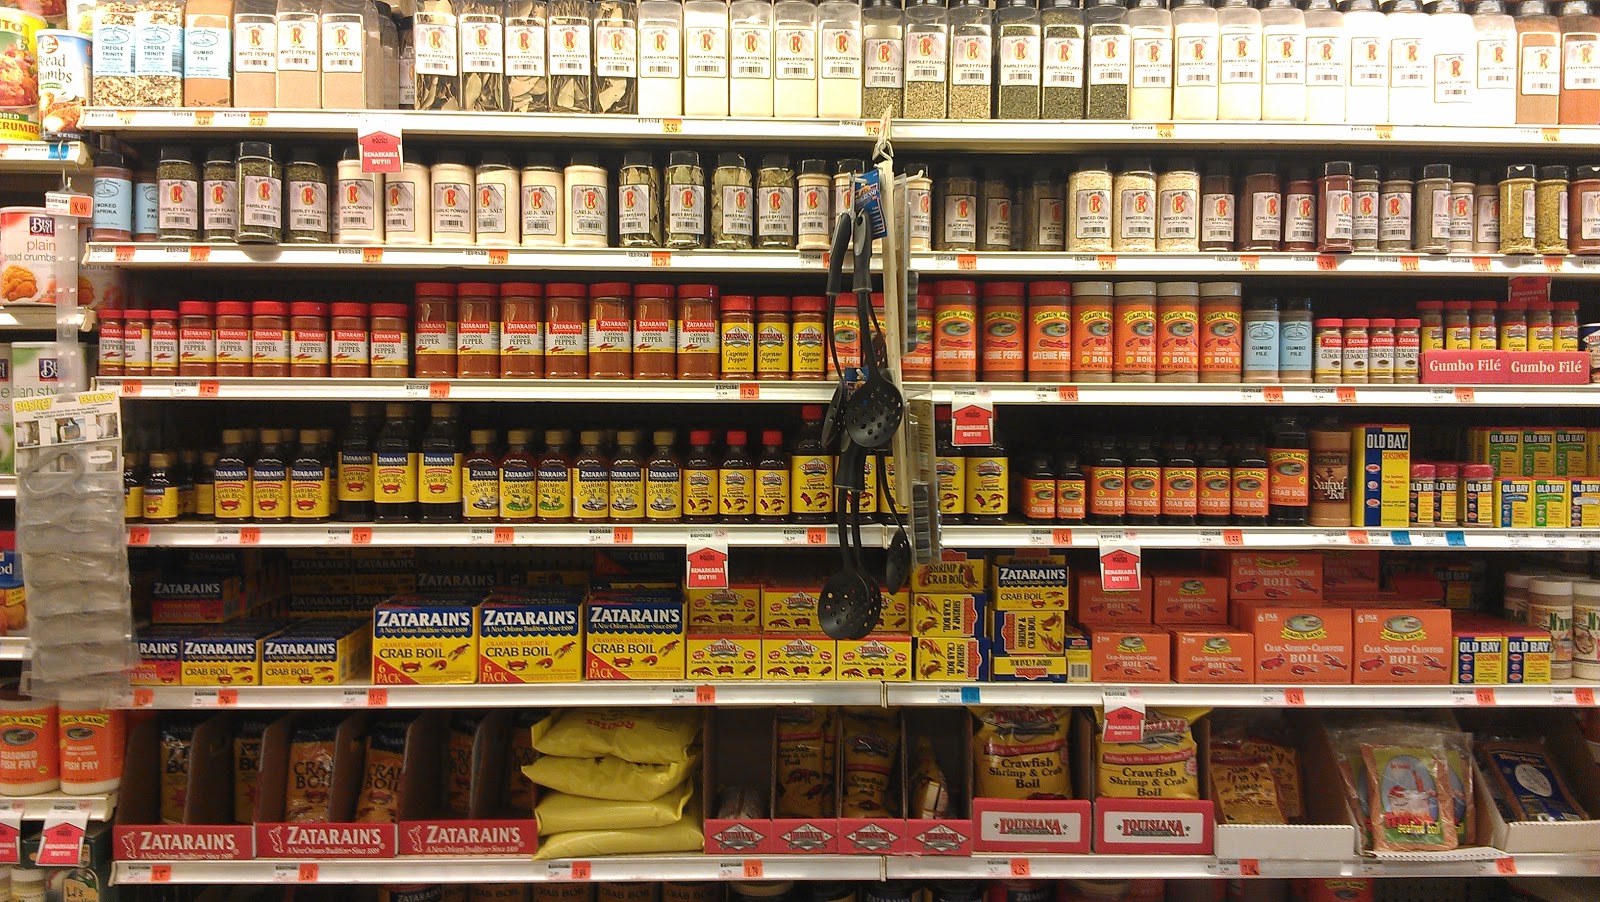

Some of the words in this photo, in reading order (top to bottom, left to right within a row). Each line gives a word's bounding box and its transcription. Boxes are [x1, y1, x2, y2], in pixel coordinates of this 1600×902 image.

[363, 151, 399, 159] REMARKABLE
[727, 356, 747, 364] Pepper
[761, 356, 780, 364] Pepper
[797, 356, 819, 365] Pepper
[1429, 360, 1474, 372] Gumbo
[1477, 359, 1502, 371] Filé
[1511, 361, 1557, 373] Gumbo
[1558, 361, 1583, 373] Filé
[15, 397, 52, 413] BASKET
[1366, 433, 1386, 450] OLD
[1387, 434, 1408, 450] BAY
[1490, 433, 1502, 443] OLD
[1503, 433, 1518, 443] BAY
[1524, 433, 1536, 443] OLD
[1537, 433, 1551, 443] BAY
[1557, 432, 1569, 443] OLD
[1570, 432, 1584, 443] BAY
[1382, 452, 1408, 461] SEASONING
[1271, 489, 1290, 497] CRAB
[1290, 489, 1309, 497] BOIL
[1467, 483, 1481, 492] OLD
[1502, 483, 1515, 493] OLD
[1515, 483, 1529, 493] BAY
[1536, 483, 1549, 493] OLD
[1550, 483, 1564, 493] BAY
[1572, 483, 1585, 492] OLD
[1585, 483, 1600, 493] BAY
[929, 563, 956, 573] SHRIMP
[927, 574, 946, 584] CRAB
[947, 574, 965, 584] BOIL
[999, 568, 1066, 580] ZATARAIN'S
[1262, 577, 1291, 587] BOIL
[153, 582, 221, 595] ZATARAIN'S
[1000, 593, 1023, 601] CRAB
[1023, 593, 1044, 601] BOIL
[943, 598, 952, 616] CRAB
[377, 609, 471, 627] ZATARAIN'S
[483, 609, 577, 626] ZATARAIN'S
[591, 606, 680, 623] ZATARAIN'S
[1257, 613, 1265, 623] 6
[1264, 613, 1278, 621] PAK
[1357, 614, 1365, 624] 6
[1365, 614, 1378, 622] PAK
[943, 616, 952, 632] BOIL
[1027, 615, 1036, 631] BOIL
[1027, 632, 1036, 649] CRAB
[184, 642, 255, 655] ZATARAIN'S
[265, 642, 336, 655] ZATARAIN'S
[379, 646, 413, 658] CRAB
[415, 646, 446, 658] BOIL
[485, 646, 519, 657] CRAB
[522, 646, 552, 657] BOIL
[592, 643, 626, 654] CRAB
[627, 643, 657, 654] BOIL
[947, 642, 956, 660] CRAB
[1459, 642, 1479, 653] OLD
[1480, 642, 1501, 653] BAY
[1508, 642, 1529, 653] OLD
[1530, 642, 1550, 653] BAY
[590, 659, 599, 668] 6
[1289, 653, 1320, 664] BOIL
[1389, 655, 1420, 665] BOIL
[379, 663, 387, 672] 6
[484, 662, 493, 672] 6
[947, 660, 956, 676] BOIL
[1122, 660, 1142, 669] BOIL
[1207, 661, 1226, 670] BOIL
[184, 667, 206, 676] CRAB
[207, 667, 230, 676] BOIL
[265, 667, 288, 677] CRAB
[290, 667, 311, 677] BOIL
[482, 671, 508, 682] PACK
[588, 667, 614, 679] PACK
[377, 672, 402, 684] PACK
[18, 760, 37, 770] FRY
[82, 761, 99, 771] FRY
[1001, 758, 1053, 769] Crawfish
[988, 767, 1027, 778] Shrimp
[1029, 768, 1038, 778] &
[1041, 766, 1063, 777] Crab
[1122, 767, 1177, 778] Crawfish
[1015, 779, 1041, 789] Boil
[1109, 777, 1148, 788] Shrimp
[1151, 777, 1161, 787] &
[1164, 776, 1188, 787] Crab
[1136, 787, 1162, 797] Boil
[999, 818, 1063, 835] LOUISIANA
[1121, 818, 1186, 837] LOUISIANA
[286, 826, 382, 845] ZATARAIN'S
[426, 825, 521, 844] ZATARAIN'S
[140, 831, 236, 851] ZATARAIN'S
